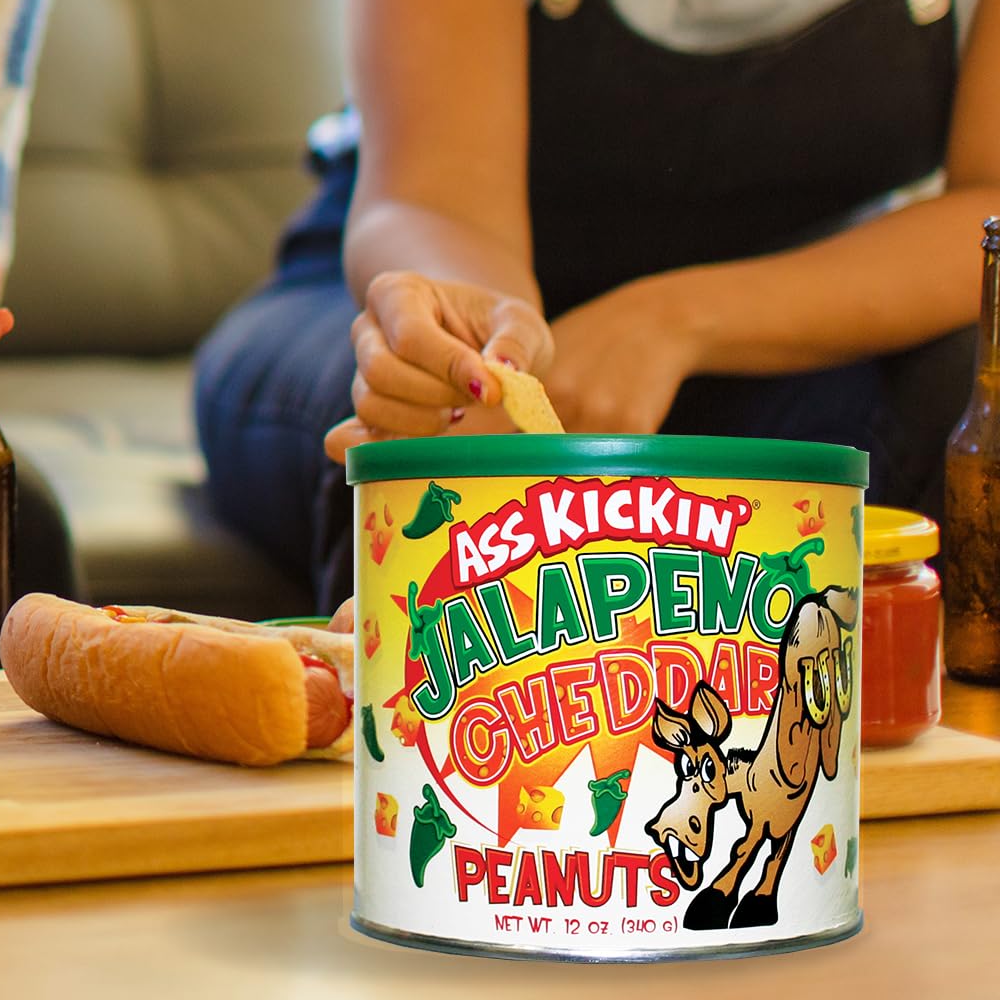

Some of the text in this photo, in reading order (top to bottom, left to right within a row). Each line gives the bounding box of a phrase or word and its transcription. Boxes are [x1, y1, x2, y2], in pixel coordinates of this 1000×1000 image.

[454, 510, 536, 583] ASS
[414, 549, 796, 720] JALAPENO
[450, 640, 781, 785] CHEDDAR
[453, 844, 681, 908] PEANUTS
[495, 915, 524, 933] NET
[528, 916, 556, 934] WT.
[564, 919, 579, 935] 12
[621, 918, 656, 935] (340
